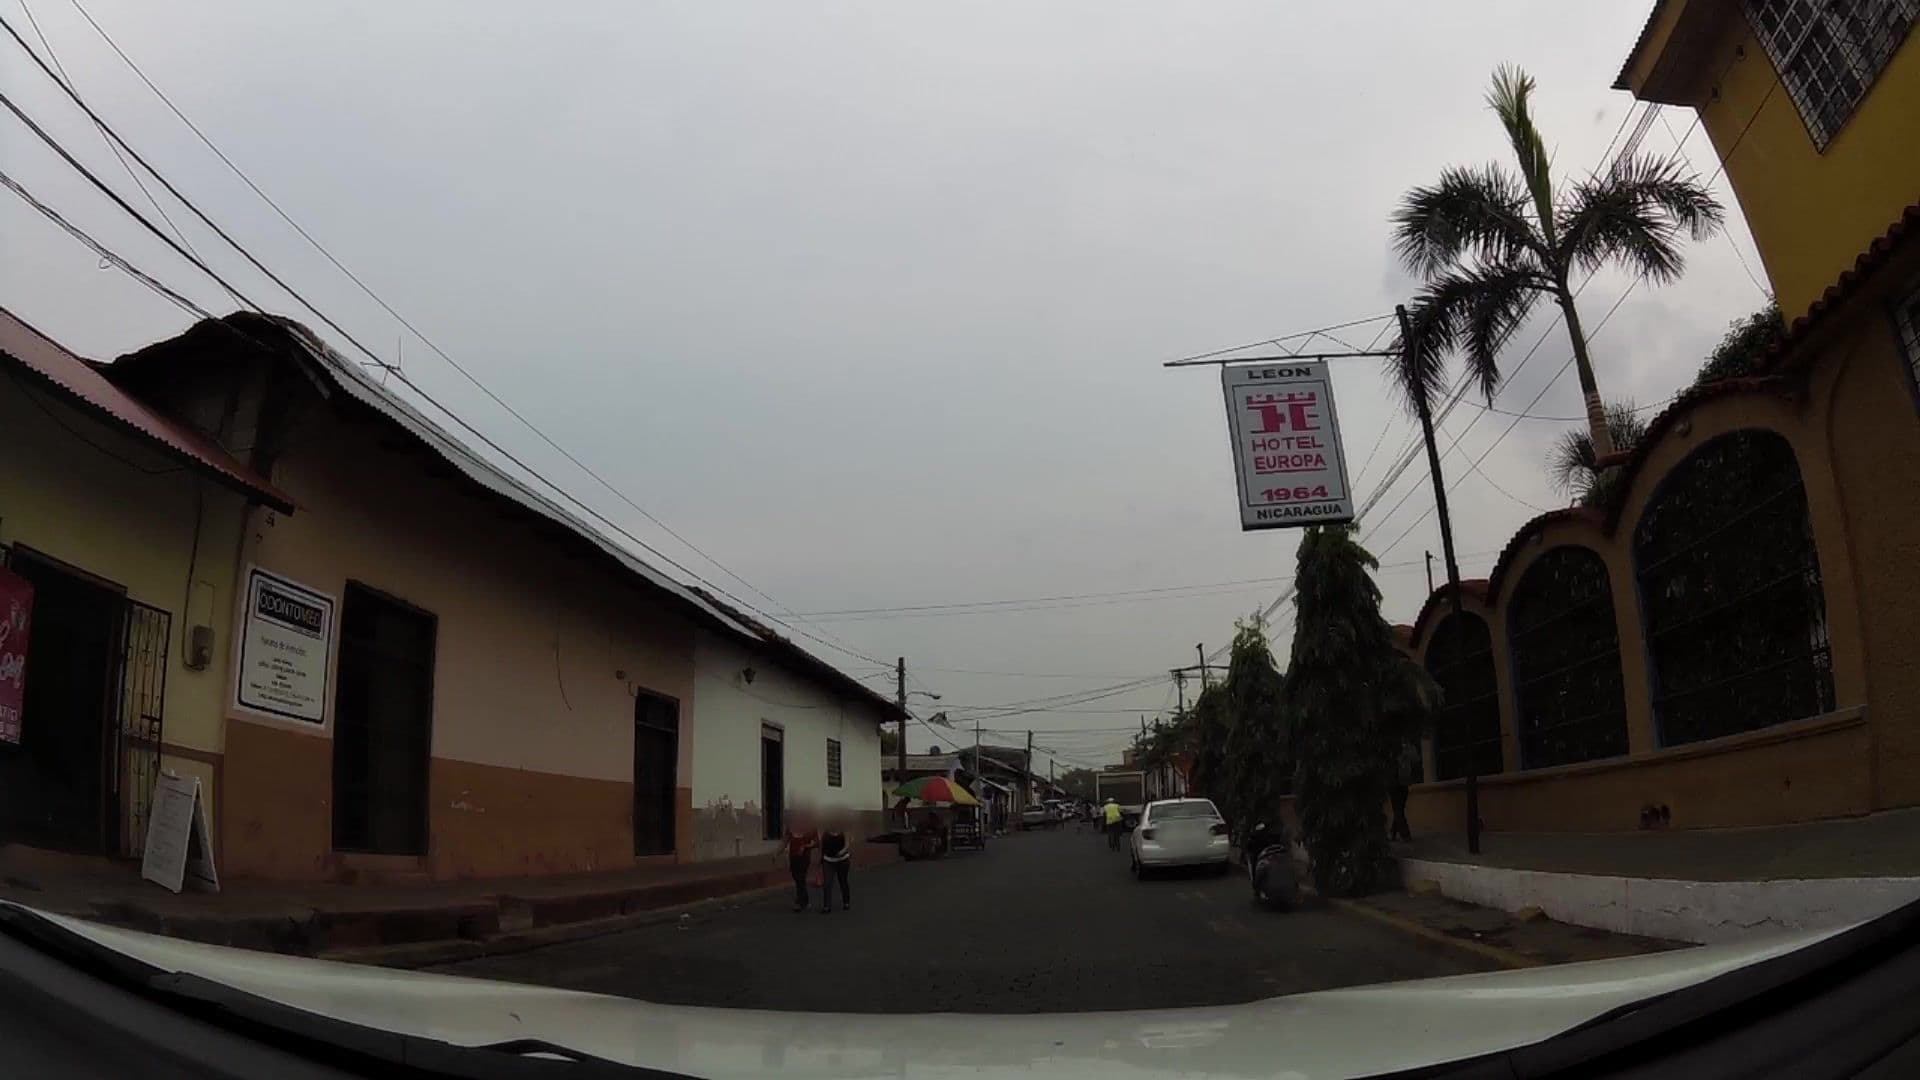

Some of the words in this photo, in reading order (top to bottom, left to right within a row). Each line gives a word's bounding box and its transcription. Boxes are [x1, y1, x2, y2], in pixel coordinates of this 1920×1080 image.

[1247, 367, 1312, 379] LEON
[1251, 436, 1324, 452] HOTEL
[1254, 454, 1327, 471] EUROPA
[1261, 485, 1329, 502] 1964
[1256, 503, 1343, 520] NICARAGUA
